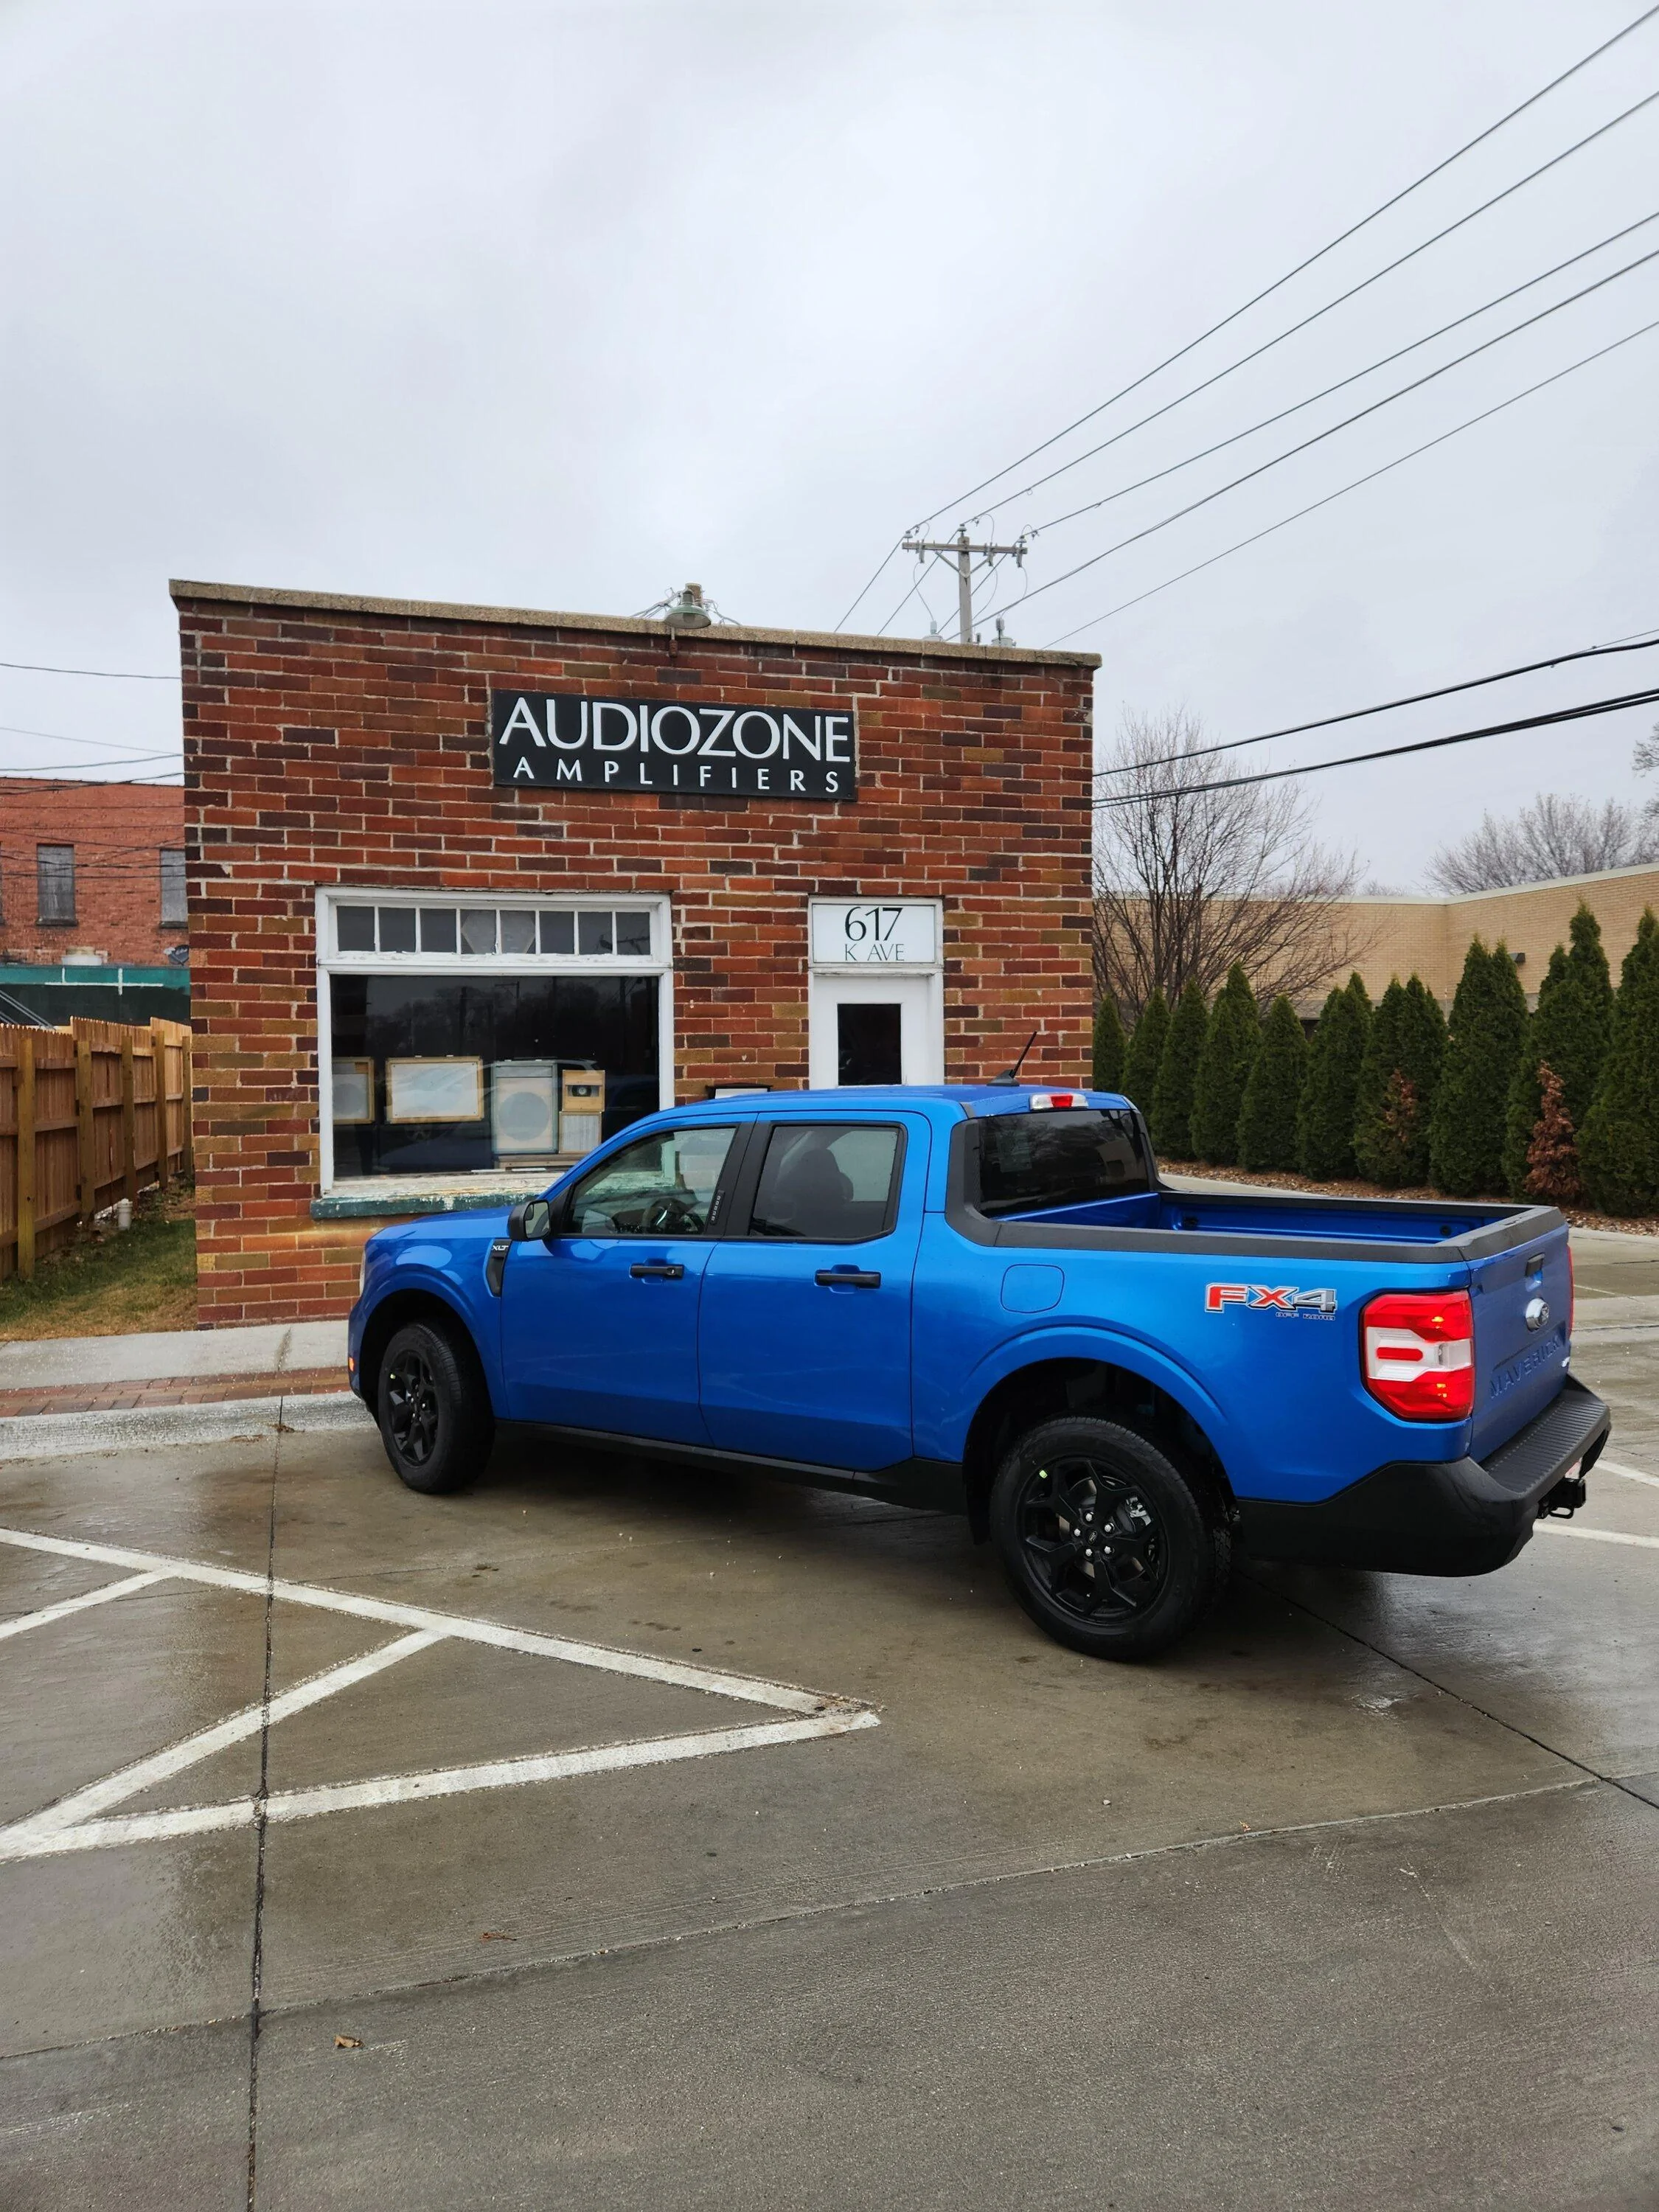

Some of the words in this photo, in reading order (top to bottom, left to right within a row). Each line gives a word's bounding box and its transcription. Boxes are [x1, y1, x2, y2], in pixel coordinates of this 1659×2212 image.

[499, 697, 850, 762] AUDIOZONE
[513, 757, 838, 793] AMPLIFIERS
[845, 906, 903, 942] 617
[845, 944, 858, 961] K
[867, 944, 905, 961] AVE
[1206, 1283, 1337, 1313] FX4
[1489, 1334, 1562, 1399] MAVERICK
